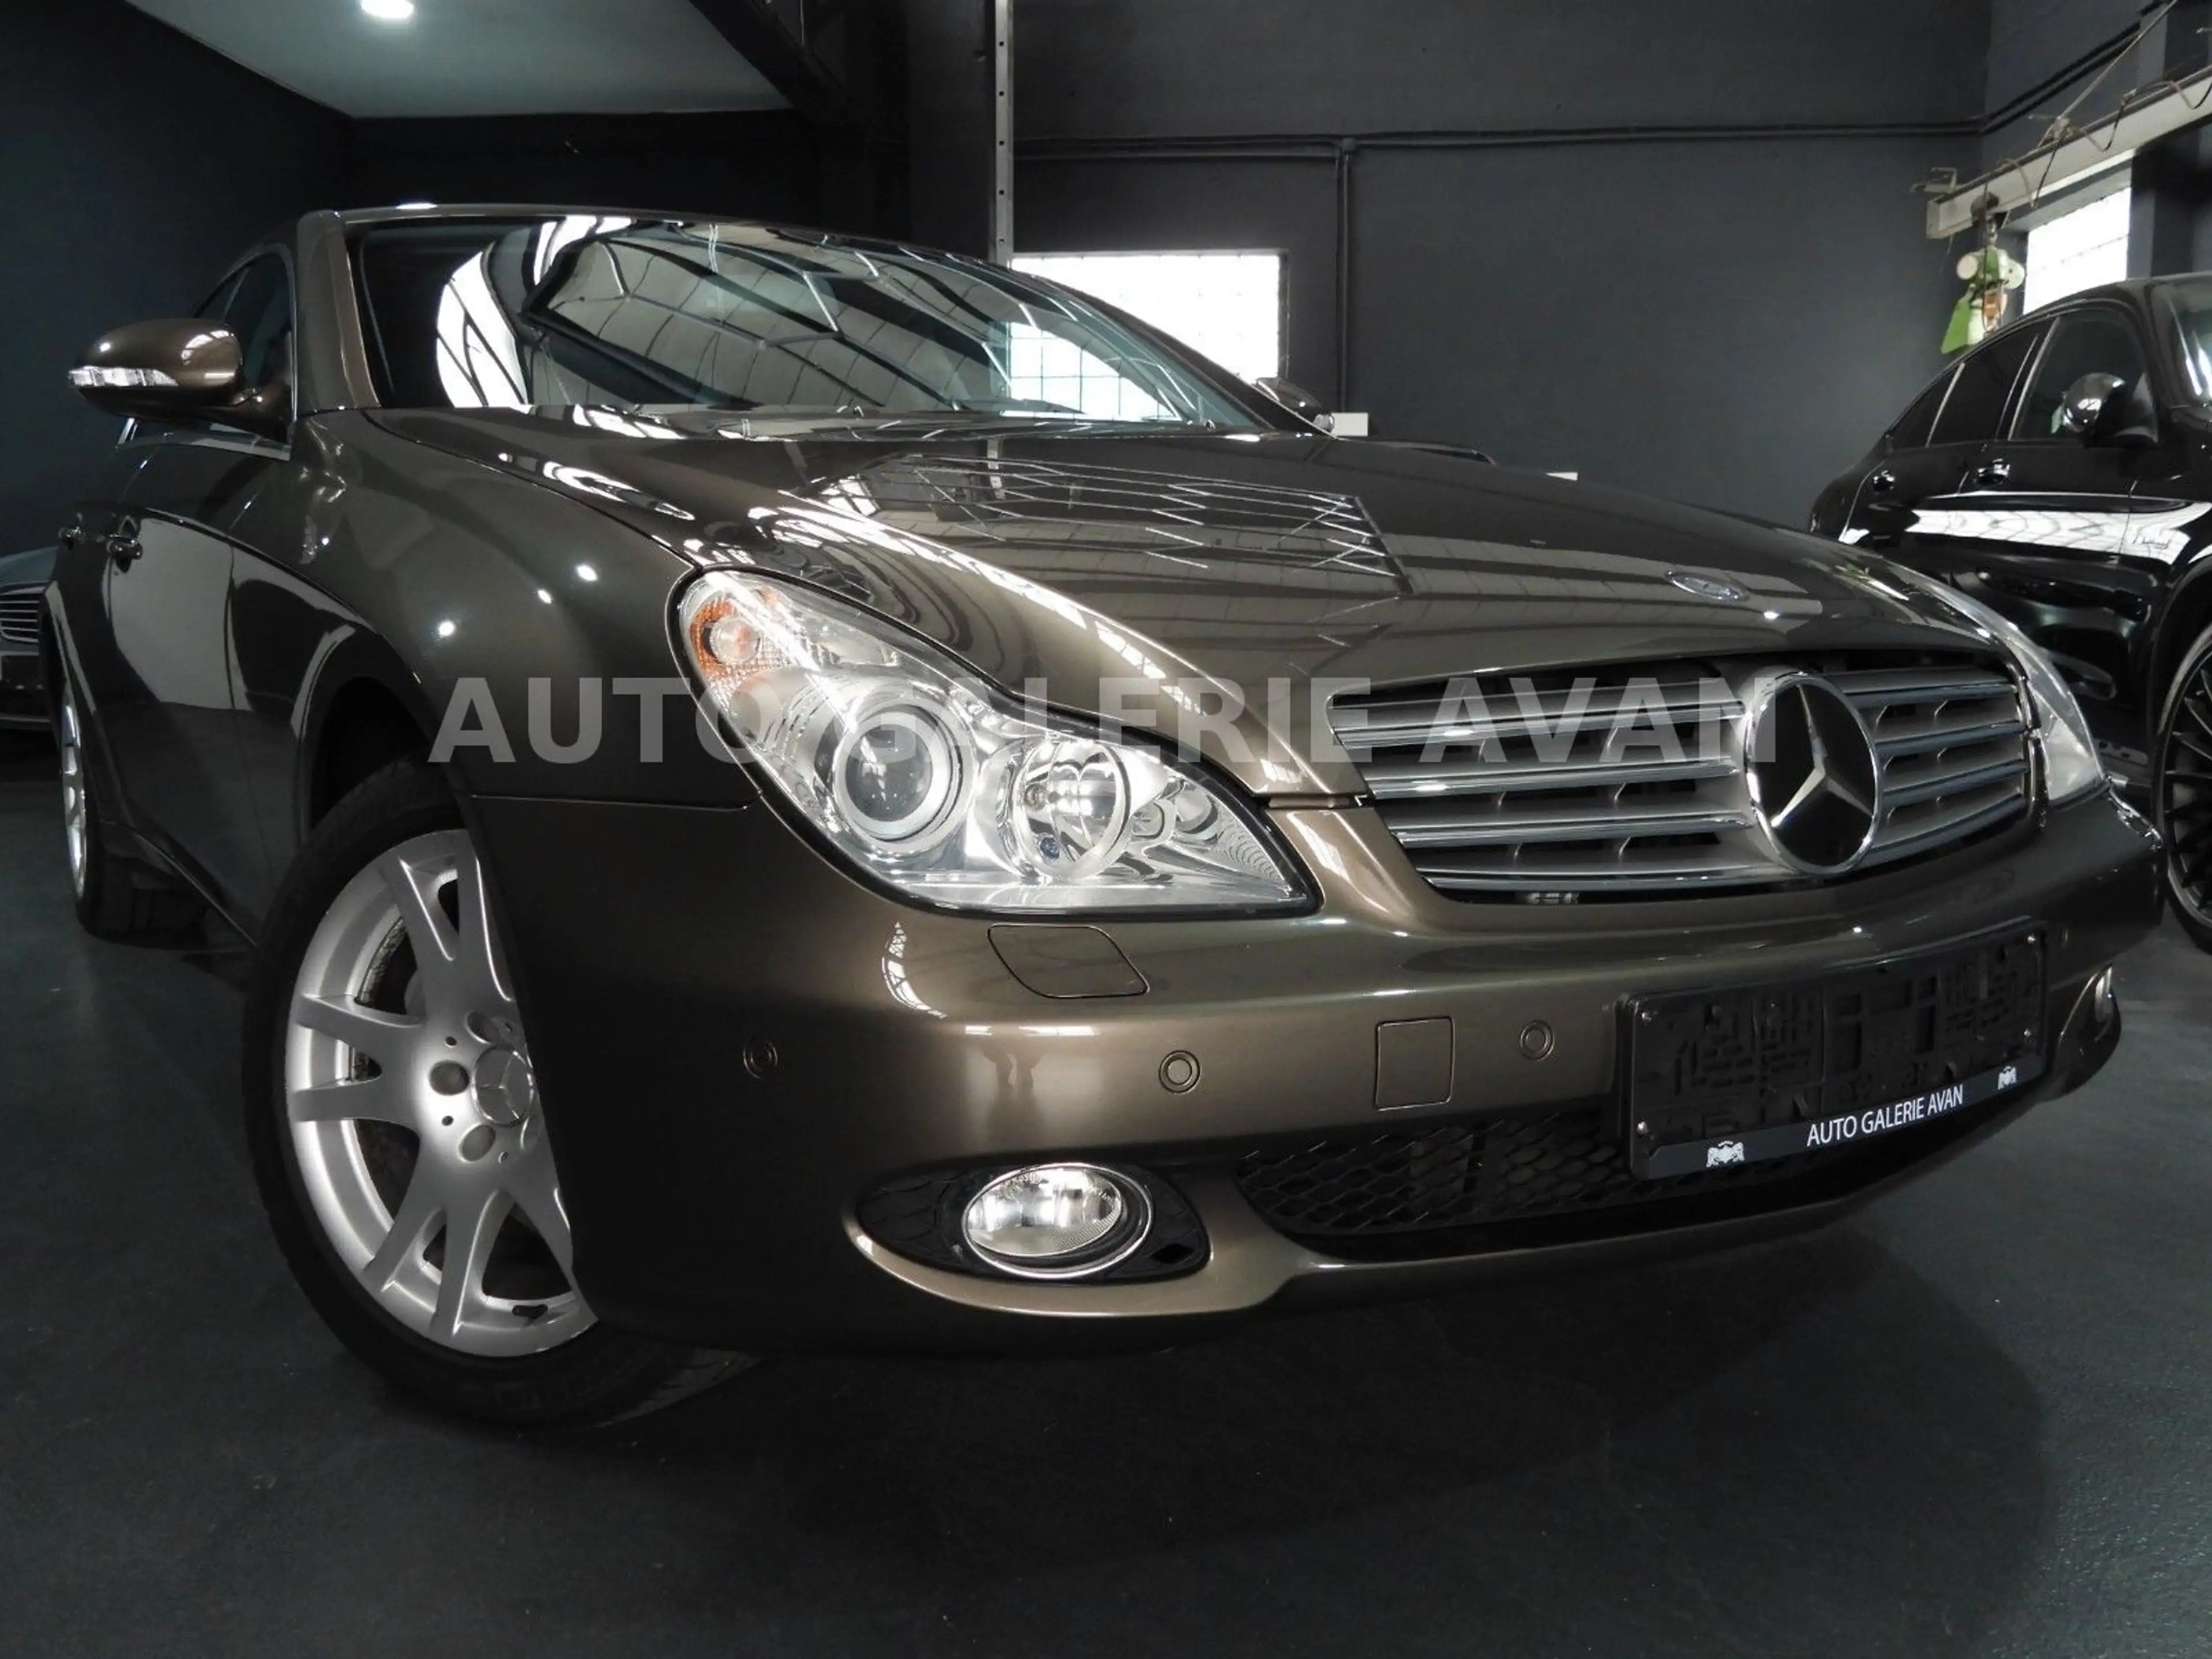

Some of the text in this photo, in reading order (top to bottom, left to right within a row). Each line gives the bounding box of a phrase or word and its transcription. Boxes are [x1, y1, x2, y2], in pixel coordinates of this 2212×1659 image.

[1806, 1084, 1963, 1147] AUTO GALERIE AVAN
